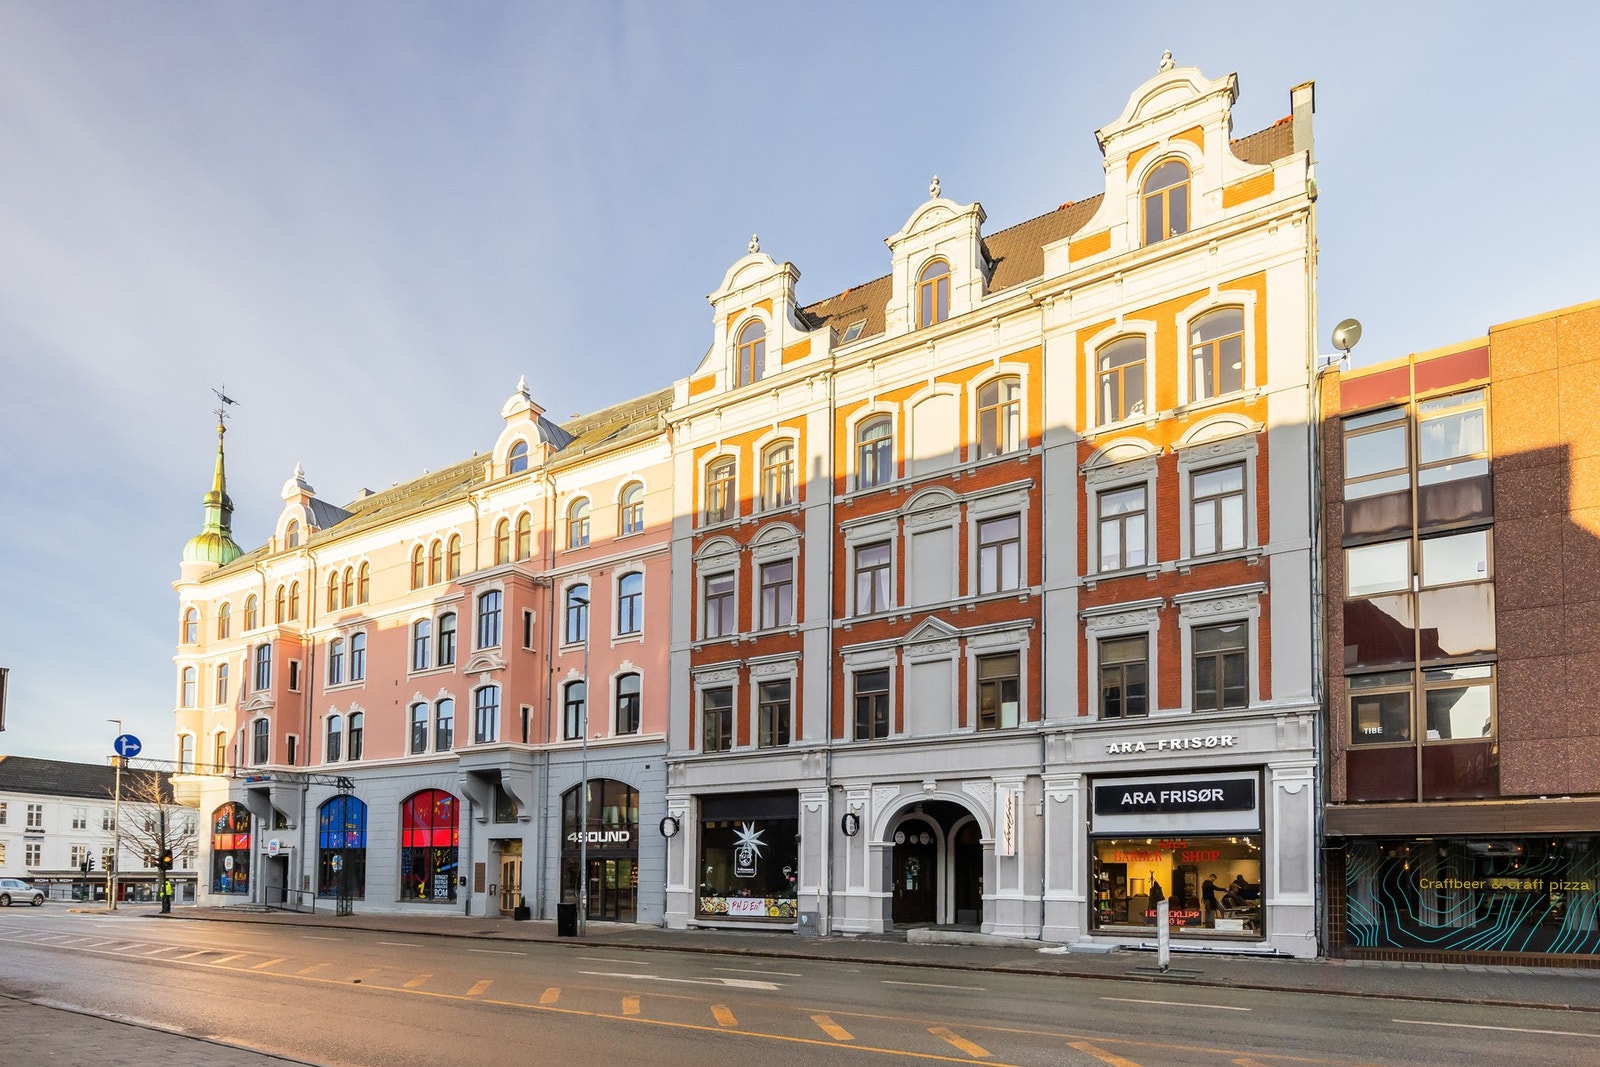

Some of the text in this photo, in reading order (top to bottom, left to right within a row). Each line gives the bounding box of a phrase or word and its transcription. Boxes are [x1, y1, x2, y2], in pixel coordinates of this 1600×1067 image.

[1363, 726, 1383, 735] TIBE
[1108, 735, 1233, 754] ARA FRISØR
[1121, 788, 1224, 805] ARA FRISØR
[567, 831, 630, 843] 4SOUND
[1181, 850, 1221, 863] SHOP
[1419, 878, 1590, 893] Craftbeer & craft pizza
